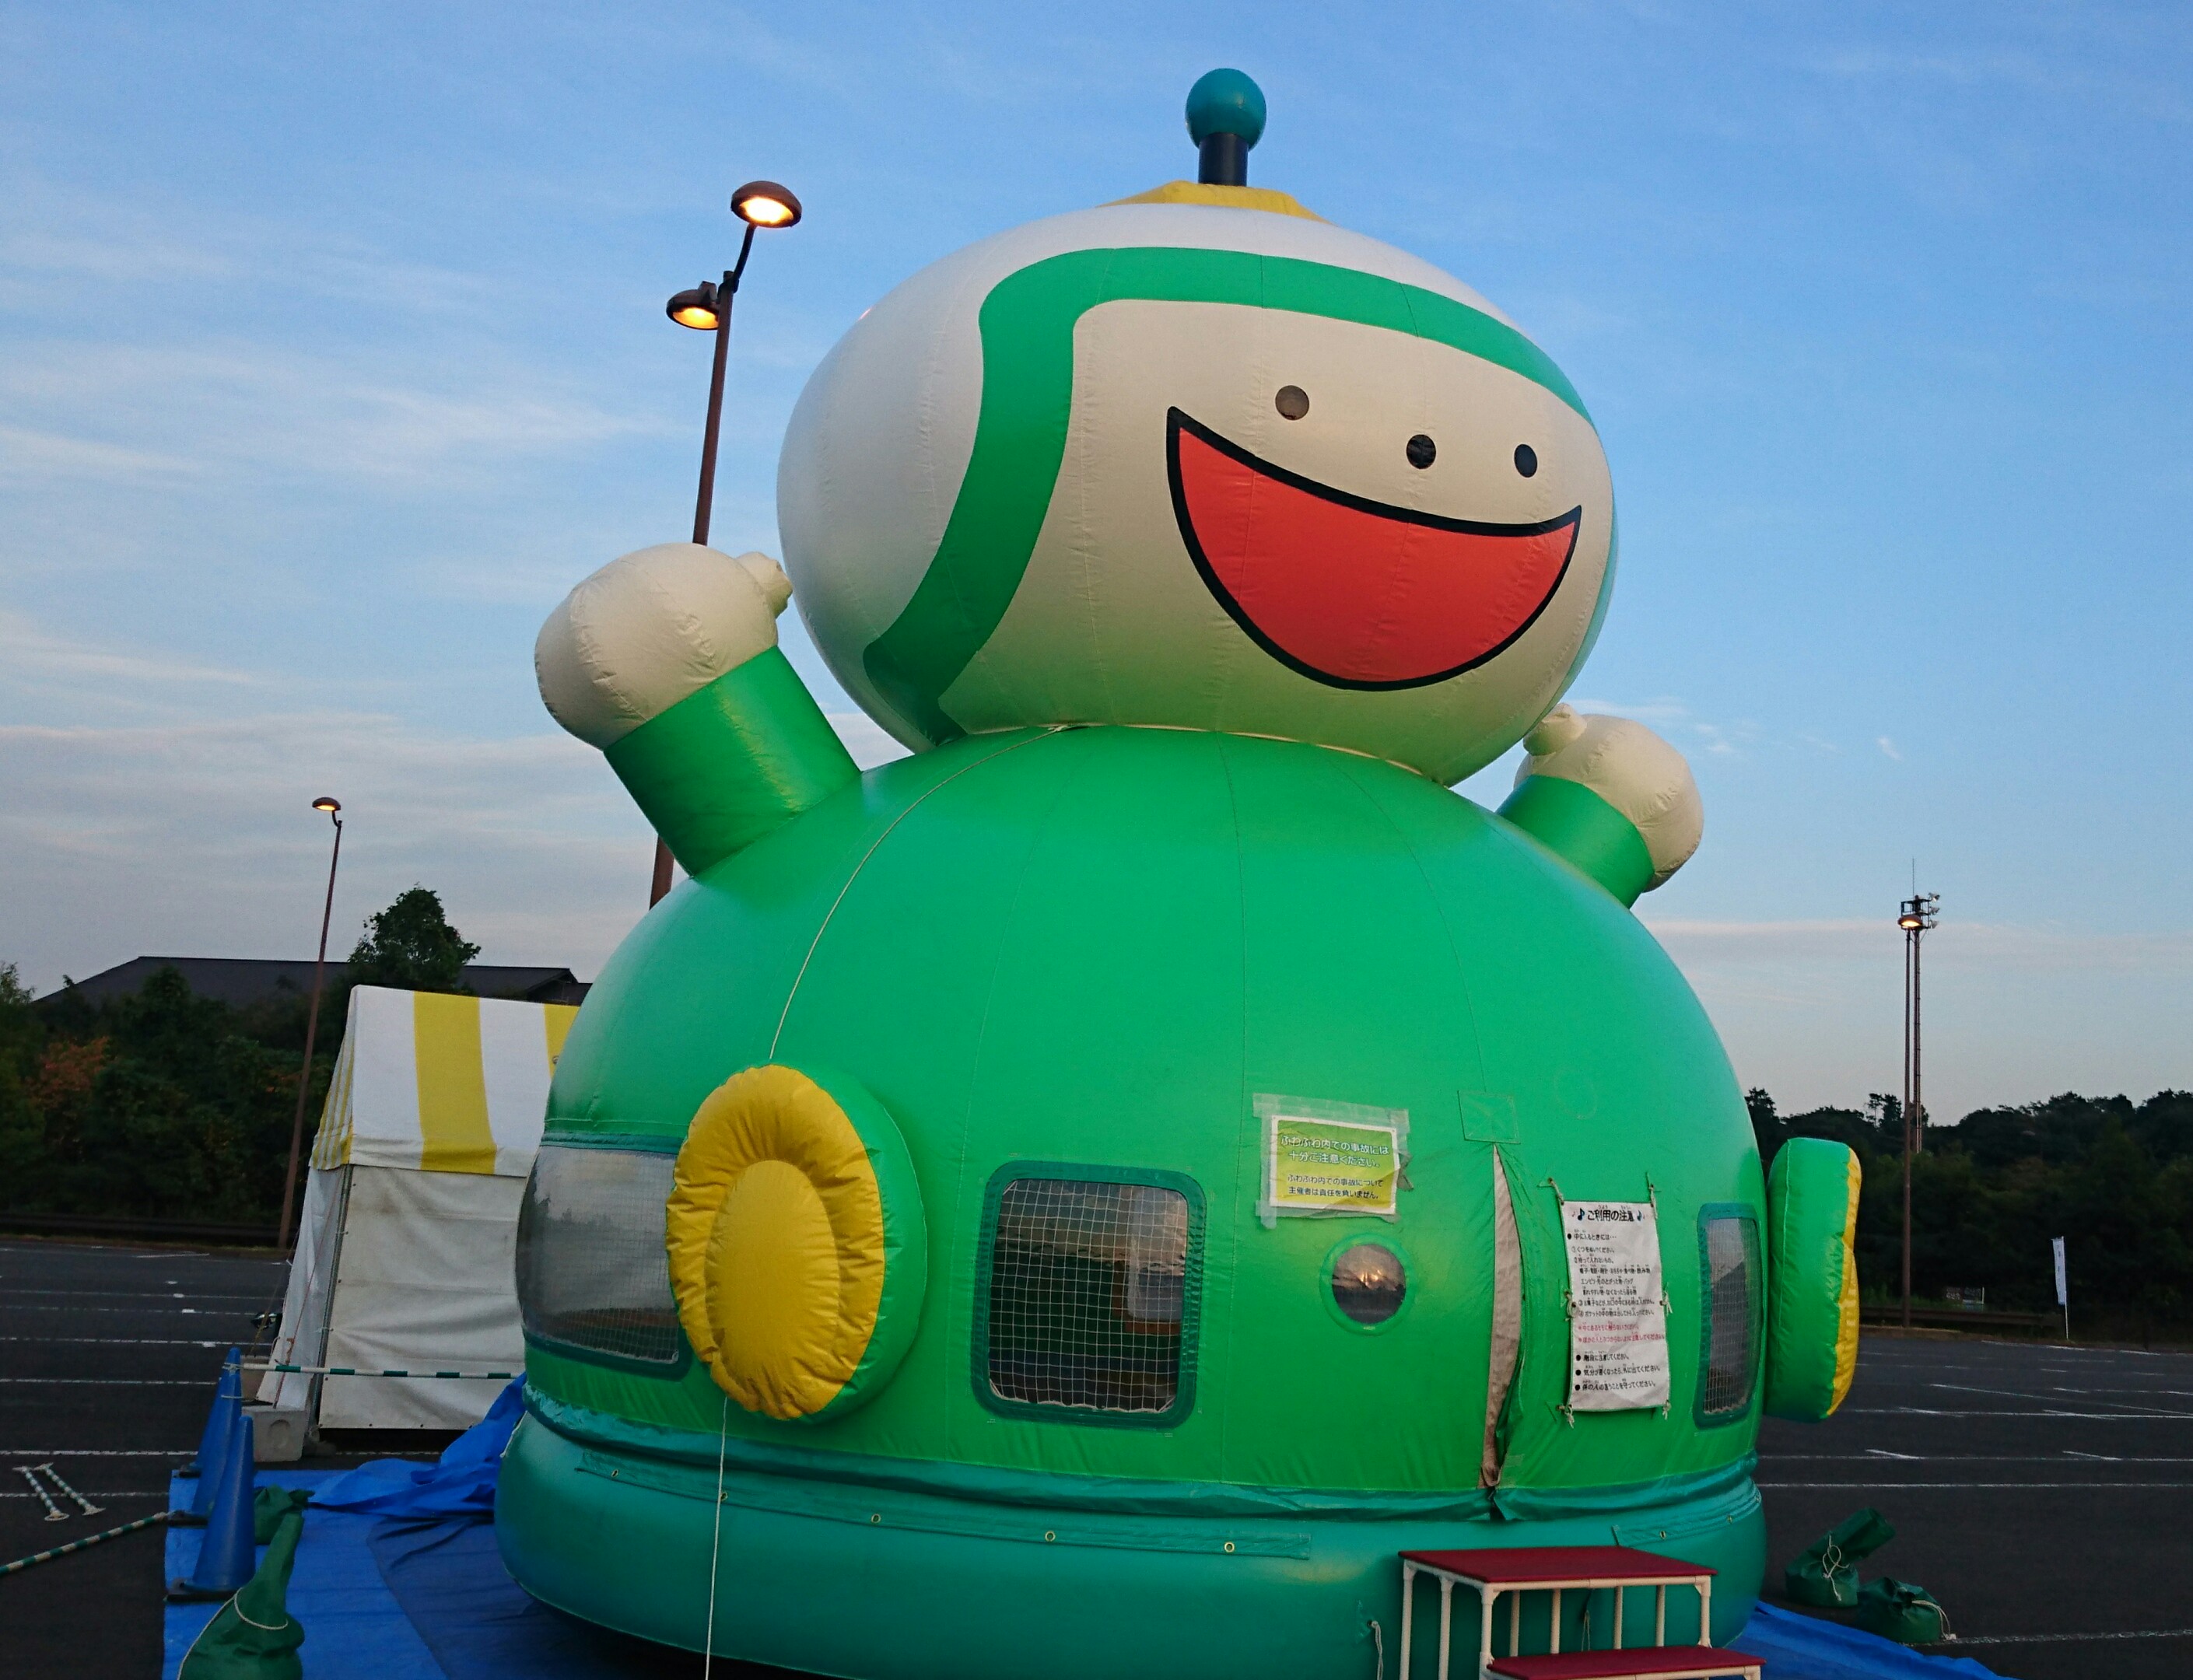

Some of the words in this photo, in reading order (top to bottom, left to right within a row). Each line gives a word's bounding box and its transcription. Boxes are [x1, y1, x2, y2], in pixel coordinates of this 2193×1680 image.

[1289, 1151, 1379, 1167] 十分ご注意ください。
[1287, 1174, 1384, 1187] ふわふわ内での事故について
[1288, 1186, 1379, 1199] 主催者は責任を負いません。
[1587, 1209, 1634, 1222] ご利用の注意
